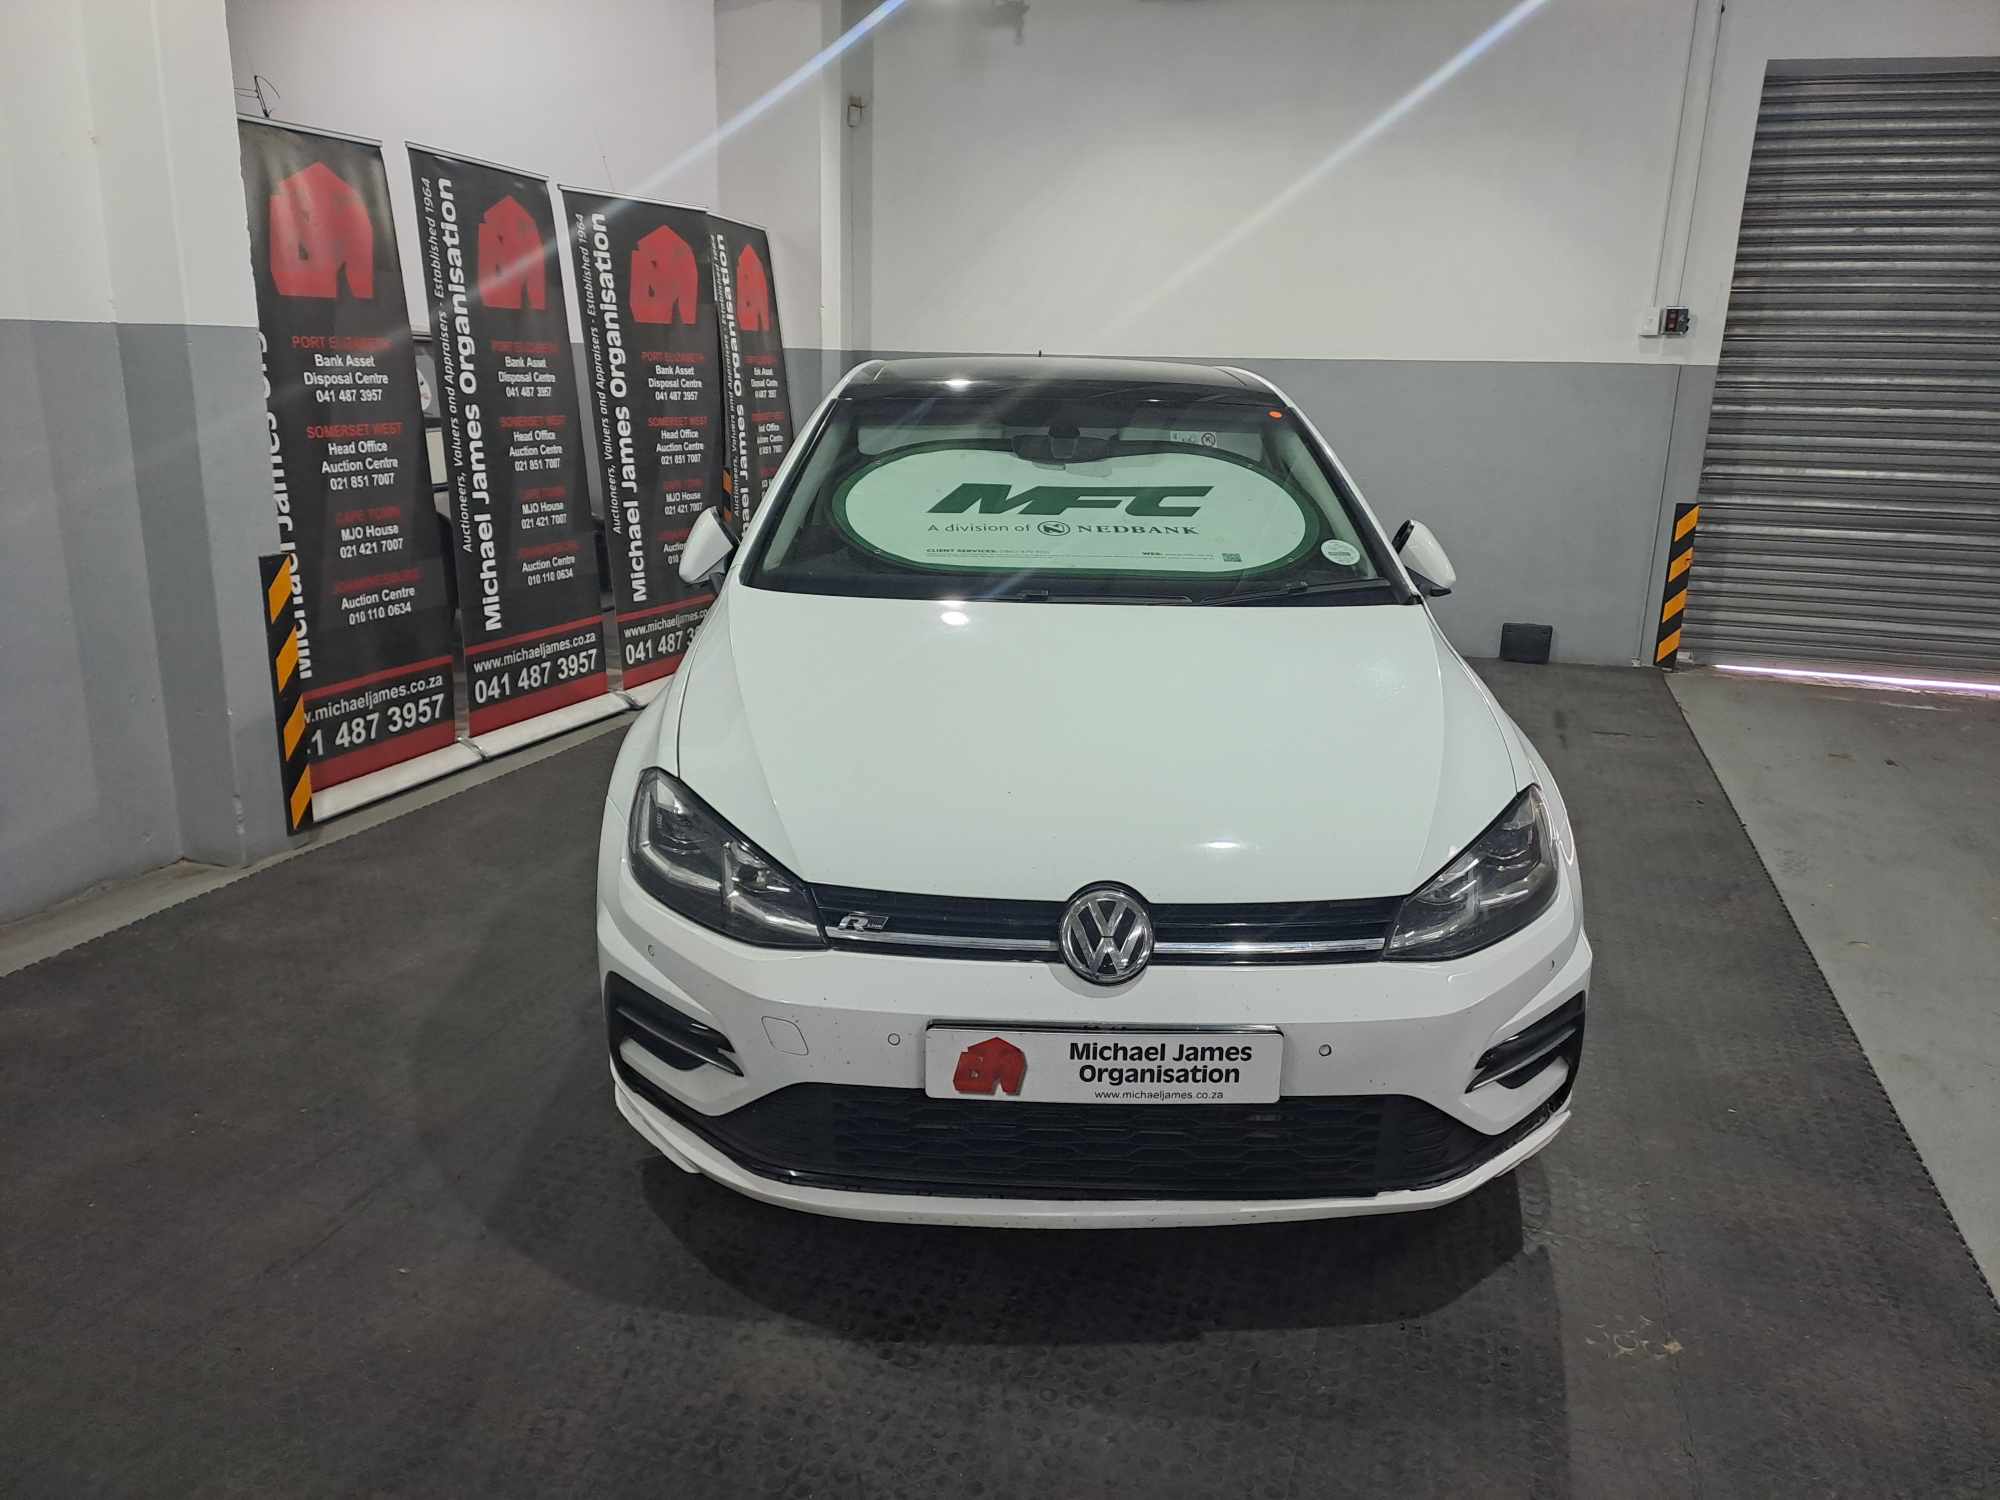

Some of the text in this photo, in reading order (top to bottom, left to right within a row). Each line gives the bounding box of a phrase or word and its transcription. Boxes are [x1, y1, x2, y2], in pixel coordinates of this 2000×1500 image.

[421, 177, 434, 214] 1964
[575, 213, 587, 243] 1964
[428, 218, 445, 298] Established
[579, 246, 597, 316] Established
[438, 310, 455, 384] Appraisers
[313, 354, 376, 367] Bank Asset
[505, 356, 525, 367] Bank
[591, 327, 606, 388] Appraisers
[304, 371, 389, 387] Disposal Centre
[498, 371, 532, 384] Disposal
[655, 365, 673, 375] Bank
[506, 387, 519, 397] 041
[648, 377, 680, 389] Disposal
[716, 234, 750, 537] hael James Organisation
[316, 388, 383, 402] 041 487 3957
[445, 386, 457, 413] and
[598, 391, 608, 414] and
[655, 391, 668, 401] 041
[438, 178, 502, 632] Michael James Organisation
[592, 213, 647, 602] Michael James Organisation
[450, 417, 463, 467] Valuers
[513, 431, 533, 442] Head
[601, 417, 614, 460] Valuers
[661, 429, 699, 439] Head Office
[328, 440, 388, 455] Head Office
[509, 446, 538, 457] Auction
[656, 442, 704, 452] Auction Centre
[321, 457, 398, 473] Auction Centre
[514, 460, 527, 471] 021
[529, 459, 543, 470] 851
[661, 455, 673, 465] 021
[330, 473, 395, 490] 021 851 7007
[522, 503, 539, 514] MJO
[607, 465, 622, 534] Auctioneers,
[926, 483, 1215, 517] MFC
[456, 472, 473, 553] Auctioneers,
[665, 505, 676, 515] 021
[521, 519, 534, 529] 021
[536, 516, 549, 527] 421
[928, 524, 939, 532] A
[945, 523, 1009, 532] division
[1014, 524, 1030, 532] of
[1077, 525, 1200, 535] NEDBANK
[341, 524, 399, 541] MJO House
[340, 538, 404, 558] 021 421 7007
[522, 556, 575, 573] Auction Centre
[341, 587, 415, 610] Auction Centre
[349, 601, 411, 625] 010 110 0634
[473, 630, 596, 673] www.michaeljames.co.za
[625, 639, 653, 665] 041
[657, 630, 683, 654] 487
[474, 648, 598, 704] 041 487 3957
[304, 675, 443, 724] .michaeljames.co.za
[335, 712, 380, 747] 487
[387, 693, 444, 733] 3957
[1069, 1042, 1252, 1062] Michael James
[1079, 1065, 1240, 1084] Organisation
[1095, 1089, 1223, 1101] www.michaeljames.co.za
